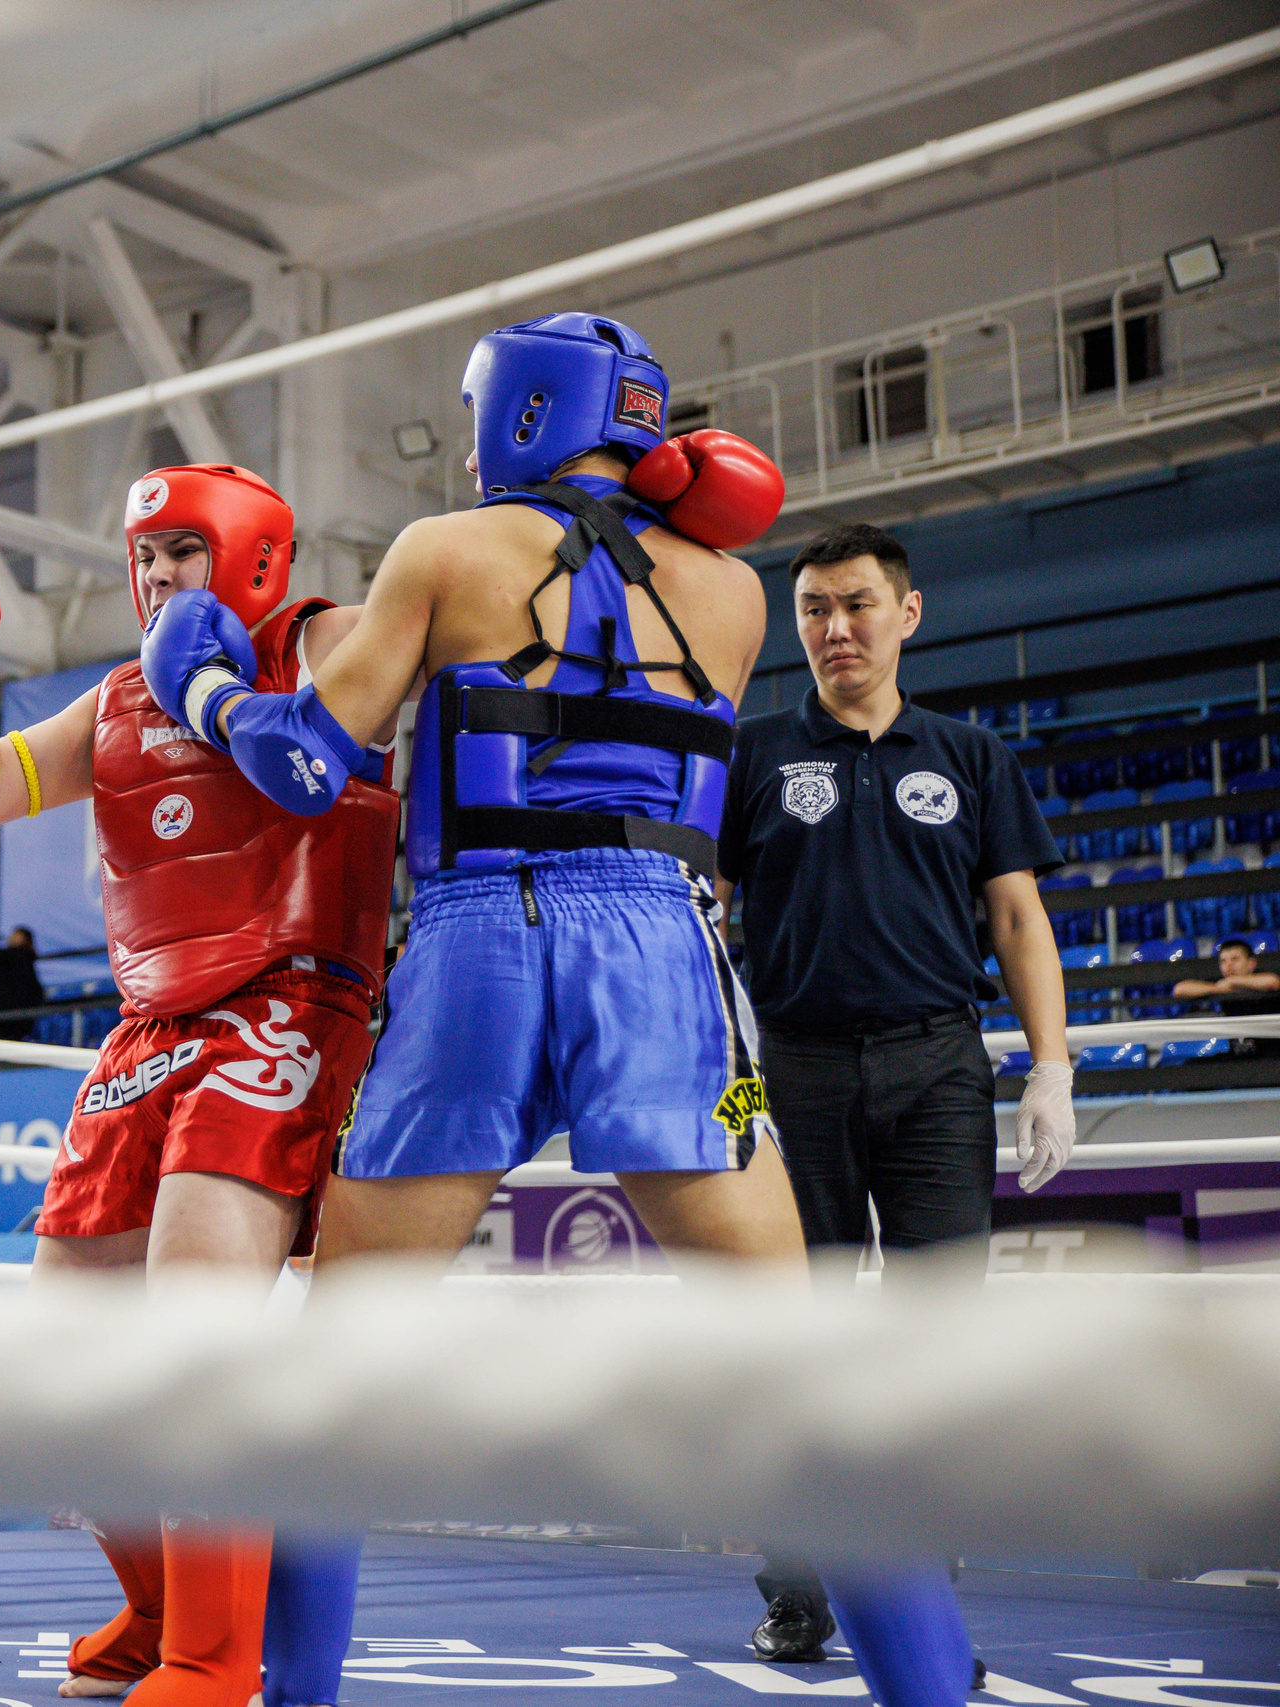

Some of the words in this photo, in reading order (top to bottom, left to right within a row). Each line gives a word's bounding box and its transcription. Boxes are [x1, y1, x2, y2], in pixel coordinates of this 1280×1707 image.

[779, 761, 837, 772] ЧЕМПИОНАТ
[783, 767, 834, 777] ПЕРВЕНСТВО
[914, 773, 953, 792] ФЕДЕРАЦИЯ
[802, 813, 821, 821] 2024
[81, 1038, 206, 1114] BOYBO
